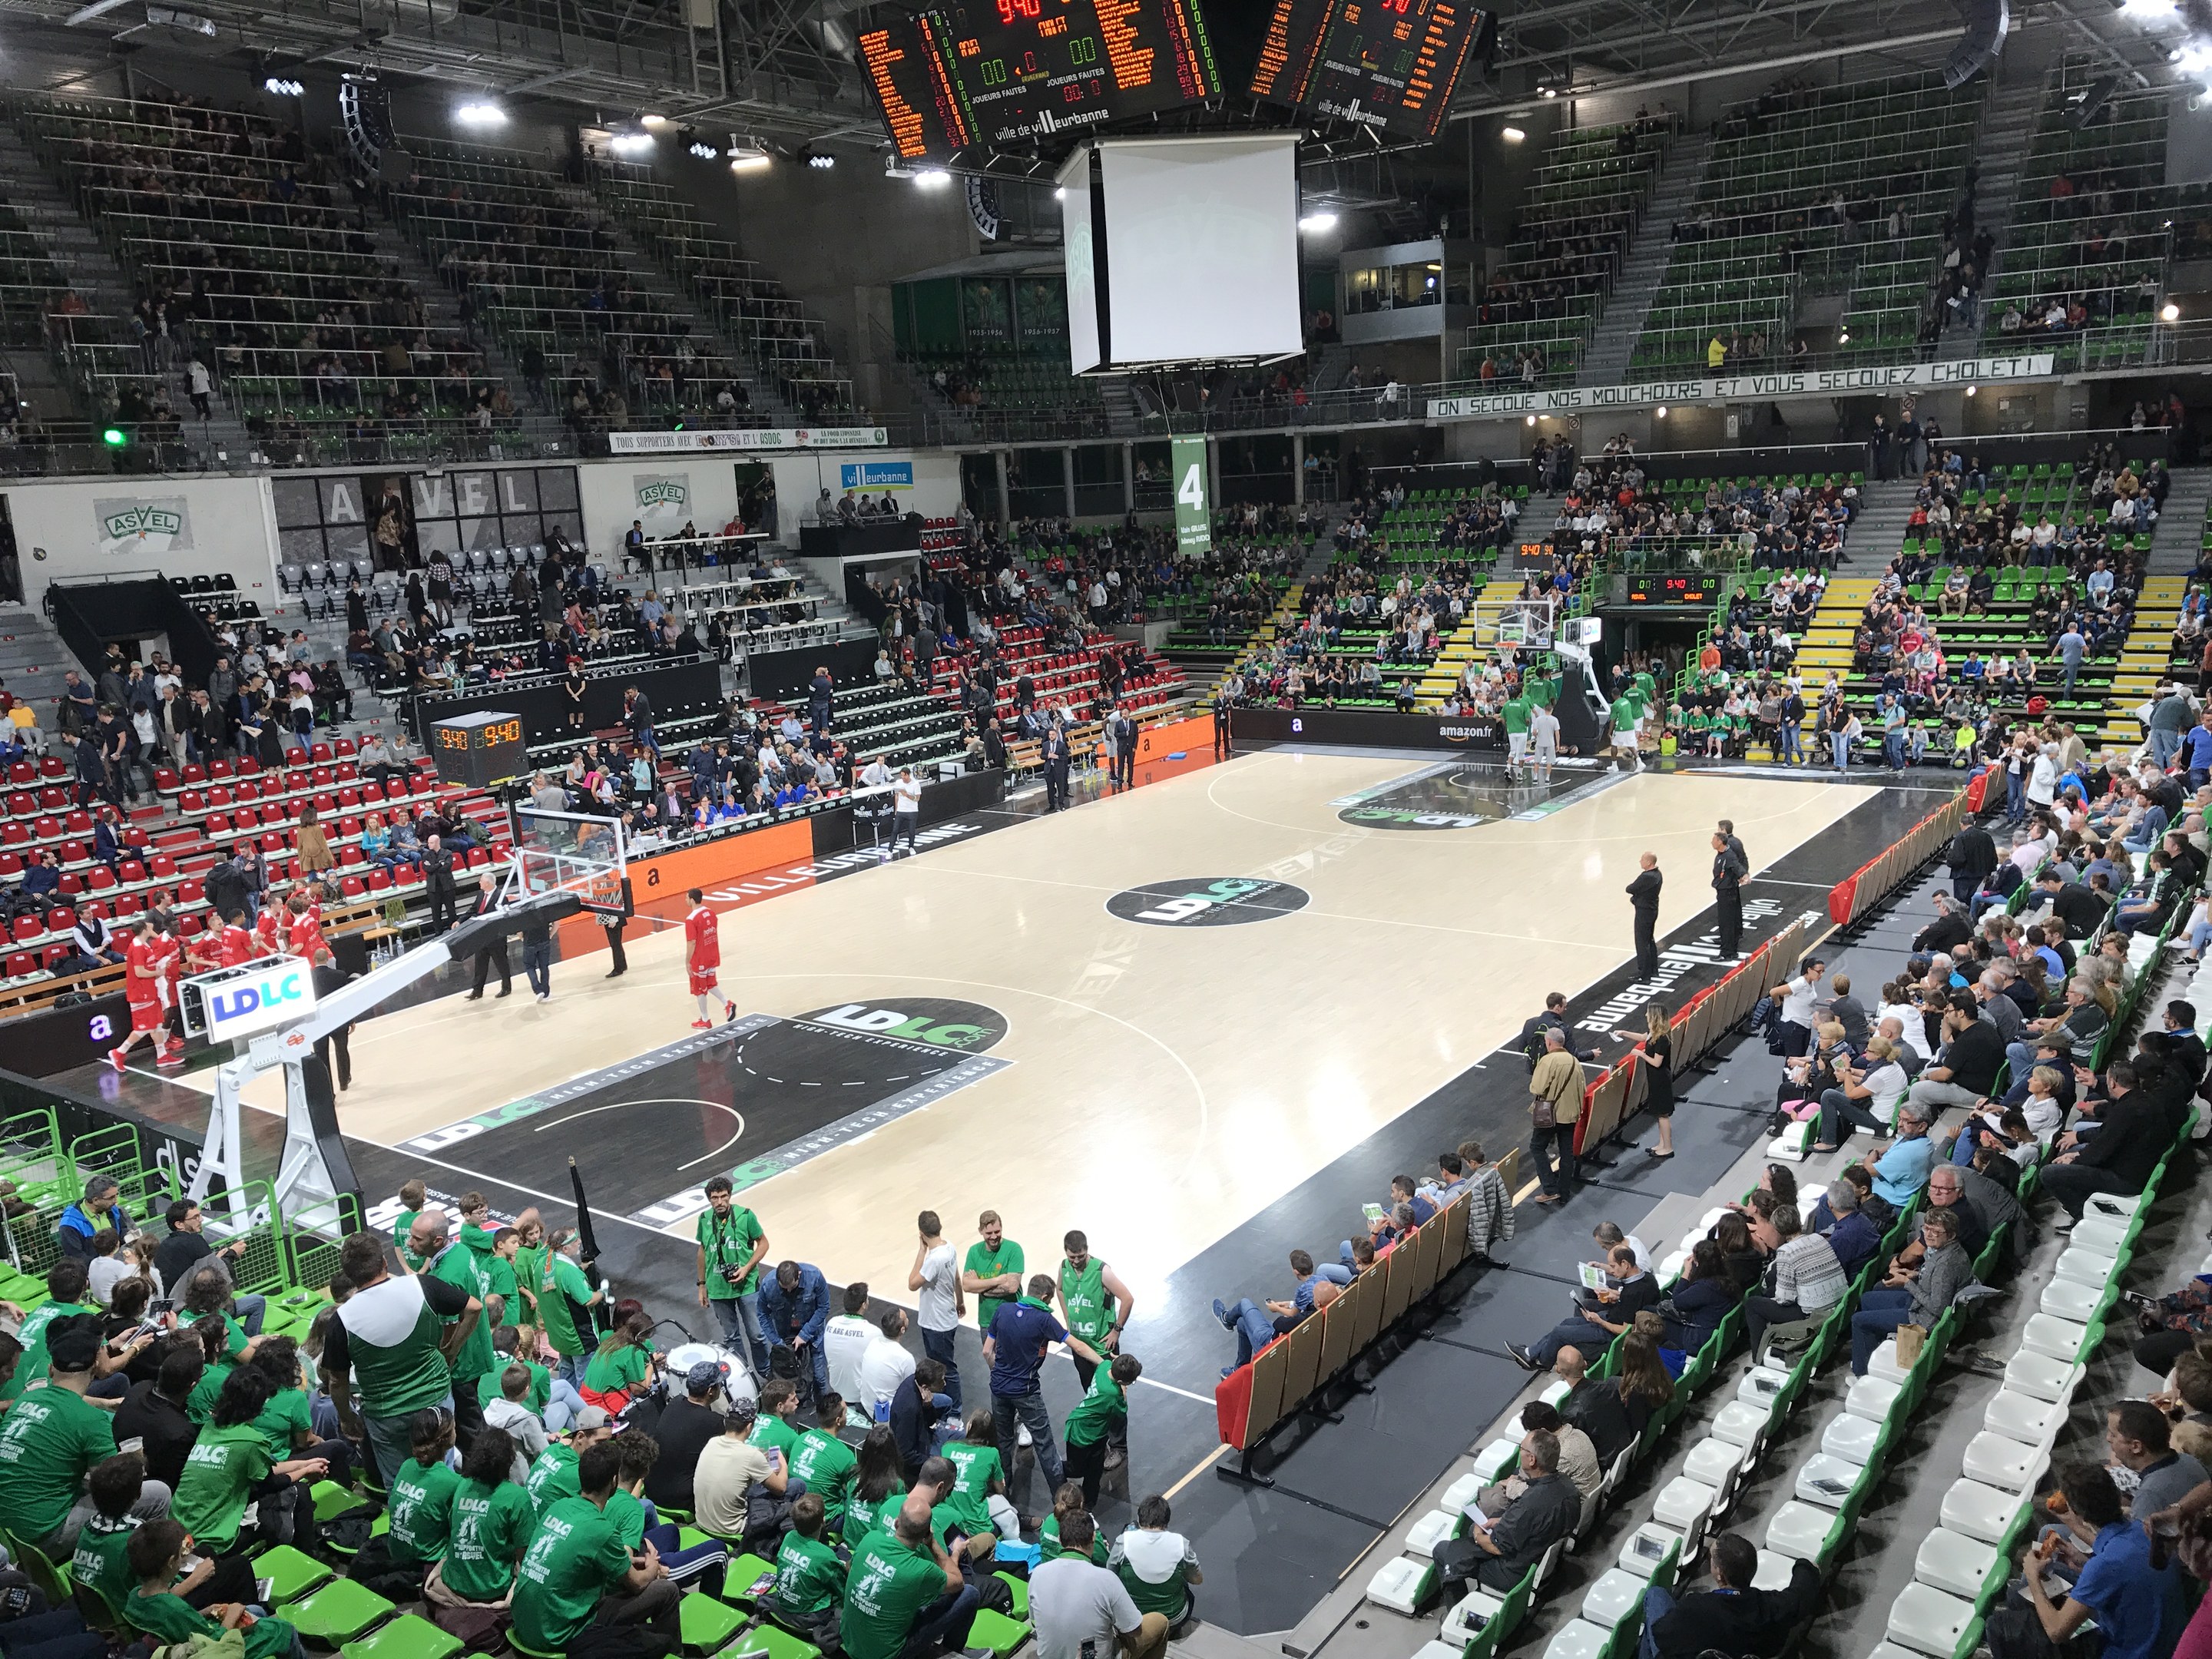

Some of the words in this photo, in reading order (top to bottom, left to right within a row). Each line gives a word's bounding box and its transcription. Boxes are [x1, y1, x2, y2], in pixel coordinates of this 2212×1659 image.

[1046, 74, 1077, 88] JOUEURS
[1078, 67, 1105, 80] FAUTES
[1324, 59, 1345, 72] JOUEURS
[1344, 65, 1361, 76] FAUTES
[1370, 73, 1389, 85] JOUEURS
[1389, 78, 1405, 89] FAUTES
[972, 90, 1002, 104] JOUEURS
[1002, 85, 1027, 98] FAUTES
[1318, 99, 1333, 114] ville
[1333, 103, 1342, 114] de
[1341, 98, 1388, 127] villeurbanne
[995, 127, 1015, 141] ville
[1018, 124, 1030, 137] de
[1032, 108, 1110, 134] villeurbanne
[1439, 400, 1459, 416] ON
[1470, 395, 1535, 414] SECOUE
[1547, 390, 1581, 409] NOS
[1592, 382, 1701, 403] MOUCHOIRS
[1715, 379, 1740, 396] ET
[1752, 376, 1805, 394] VOUS
[1819, 368, 1917, 390] SECOUEZ
[615, 436, 634, 449] TOUS
[636, 435, 675, 449] SUPPORTERS
[677, 435, 692, 447] AVEC
[743, 435, 750, 445] ET
[847, 465, 907, 486] villeurbanne
[645, 481, 681, 501] ASVEL
[1178, 464, 1203, 510] 4
[114, 505, 174, 532] ASVEL
[1702, 579, 1715, 589] 00
[1292, 717, 1303, 732] a
[1439, 724, 1493, 738] amazon.fr
[1143, 737, 1151, 752] a
[1359, 810, 1484, 828] LDLC
[647, 867, 661, 887] a
[1134, 881, 1260, 922] LDLC
[213, 973, 302, 1023] LDLC
[89, 1015, 112, 1041] a
[813, 1004, 984, 1045] LDLC
[954, 1028, 998, 1049] .com
[792, 1023, 864, 1042] HIGH-TECH
[865, 1037, 949, 1058] EXPERIENCE
[409, 1097, 541, 1151] LDLC
[550, 1057, 657, 1101] HIGH-TECH
[661, 1015, 768, 1061] EXPERIENCE
[783, 1108, 889, 1160] HIGH-TECH
[892, 1060, 998, 1110] EXPERIENCE
[1068, 1293, 1094, 1308] ASVEL
[832, 1328, 845, 1336] ARE
[844, 1330, 865, 1338] ASVEL
[803, 1434, 826, 1451] LDLC
[950, 1451, 975, 1462] LDLC
[396, 1479, 424, 1498] LDLC
[458, 1498, 488, 1512] LDLC
[542, 1515, 571, 1537] LDLC
[783, 1547, 809, 1566] LDLC
[865, 1552, 894, 1575] LDLC
